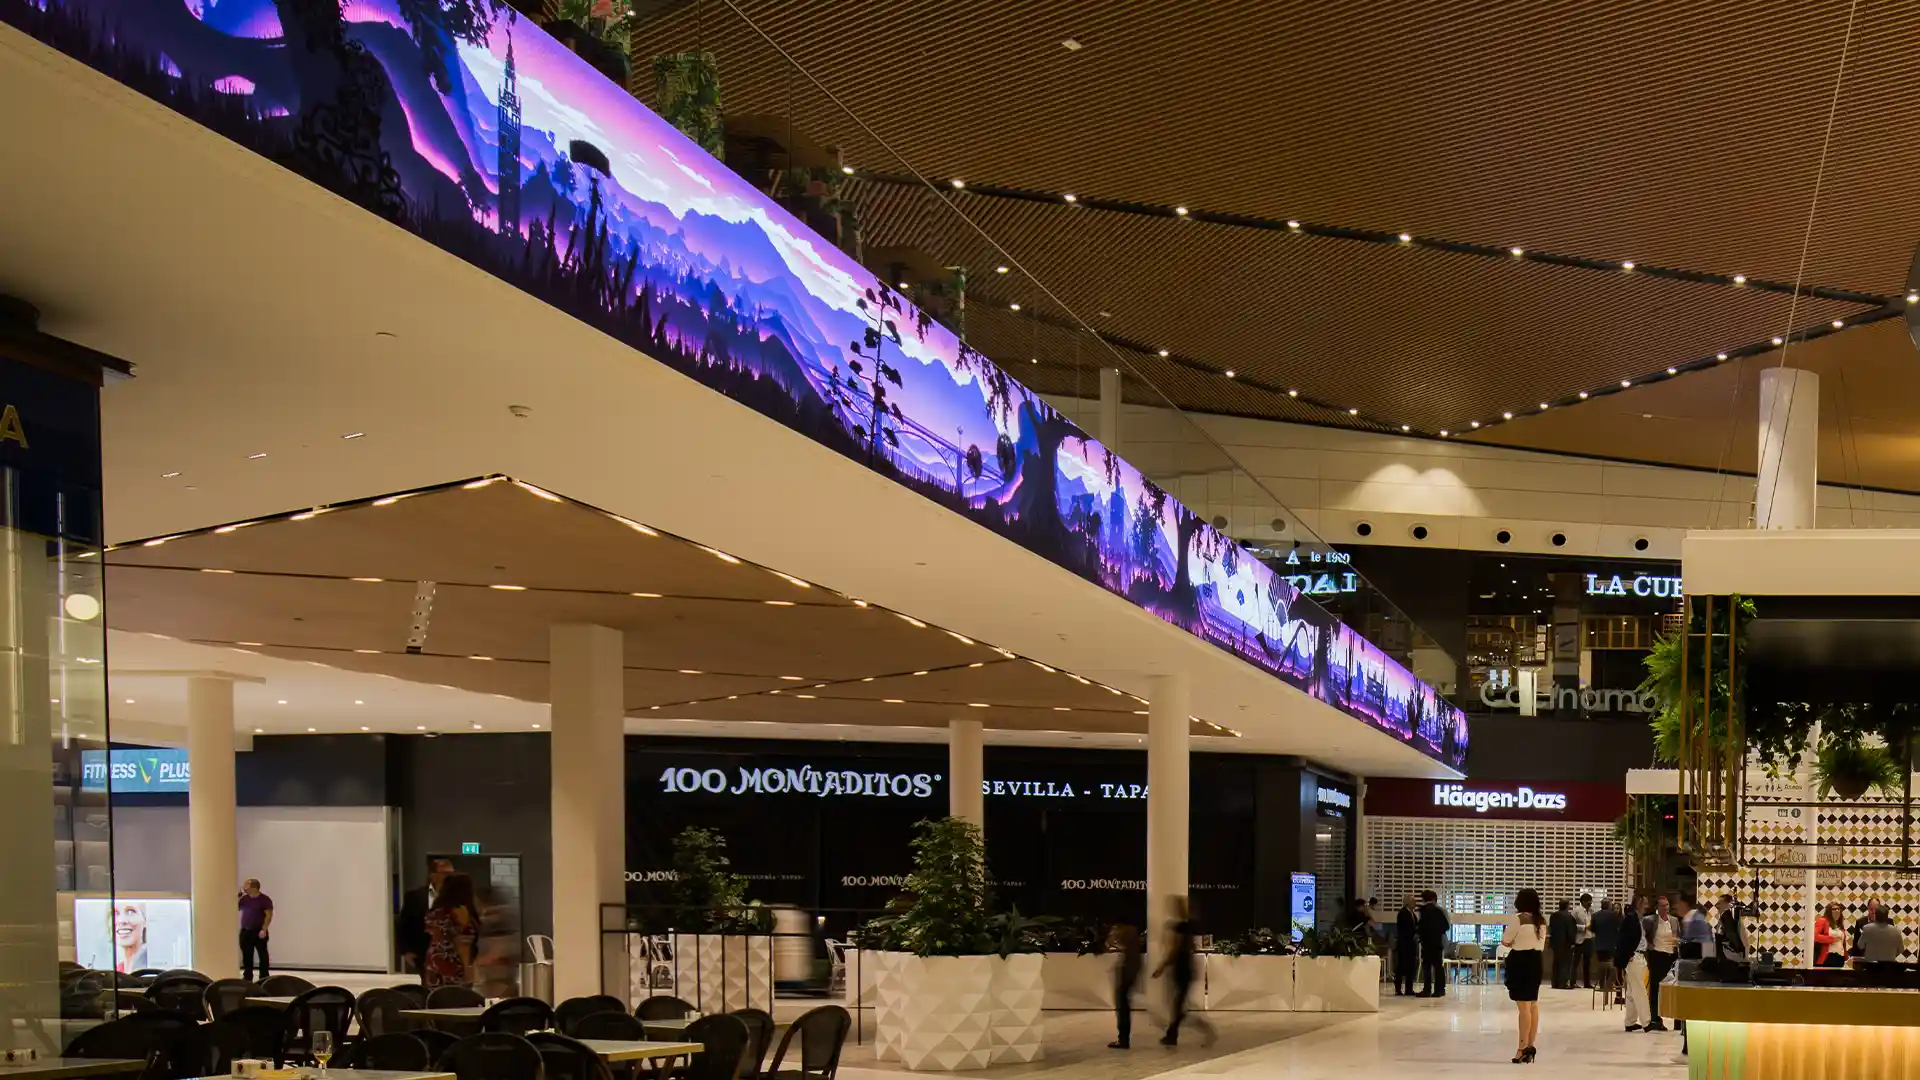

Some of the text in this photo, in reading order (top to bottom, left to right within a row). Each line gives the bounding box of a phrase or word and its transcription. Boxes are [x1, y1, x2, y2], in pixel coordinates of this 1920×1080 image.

[1586, 574, 1627, 595] LA
[659, 767, 727, 793] 100
[982, 780, 1075, 797] SEVILLA
[1434, 784, 1567, 813] Häagen-Dazs
[1061, 879, 1086, 890] 100
